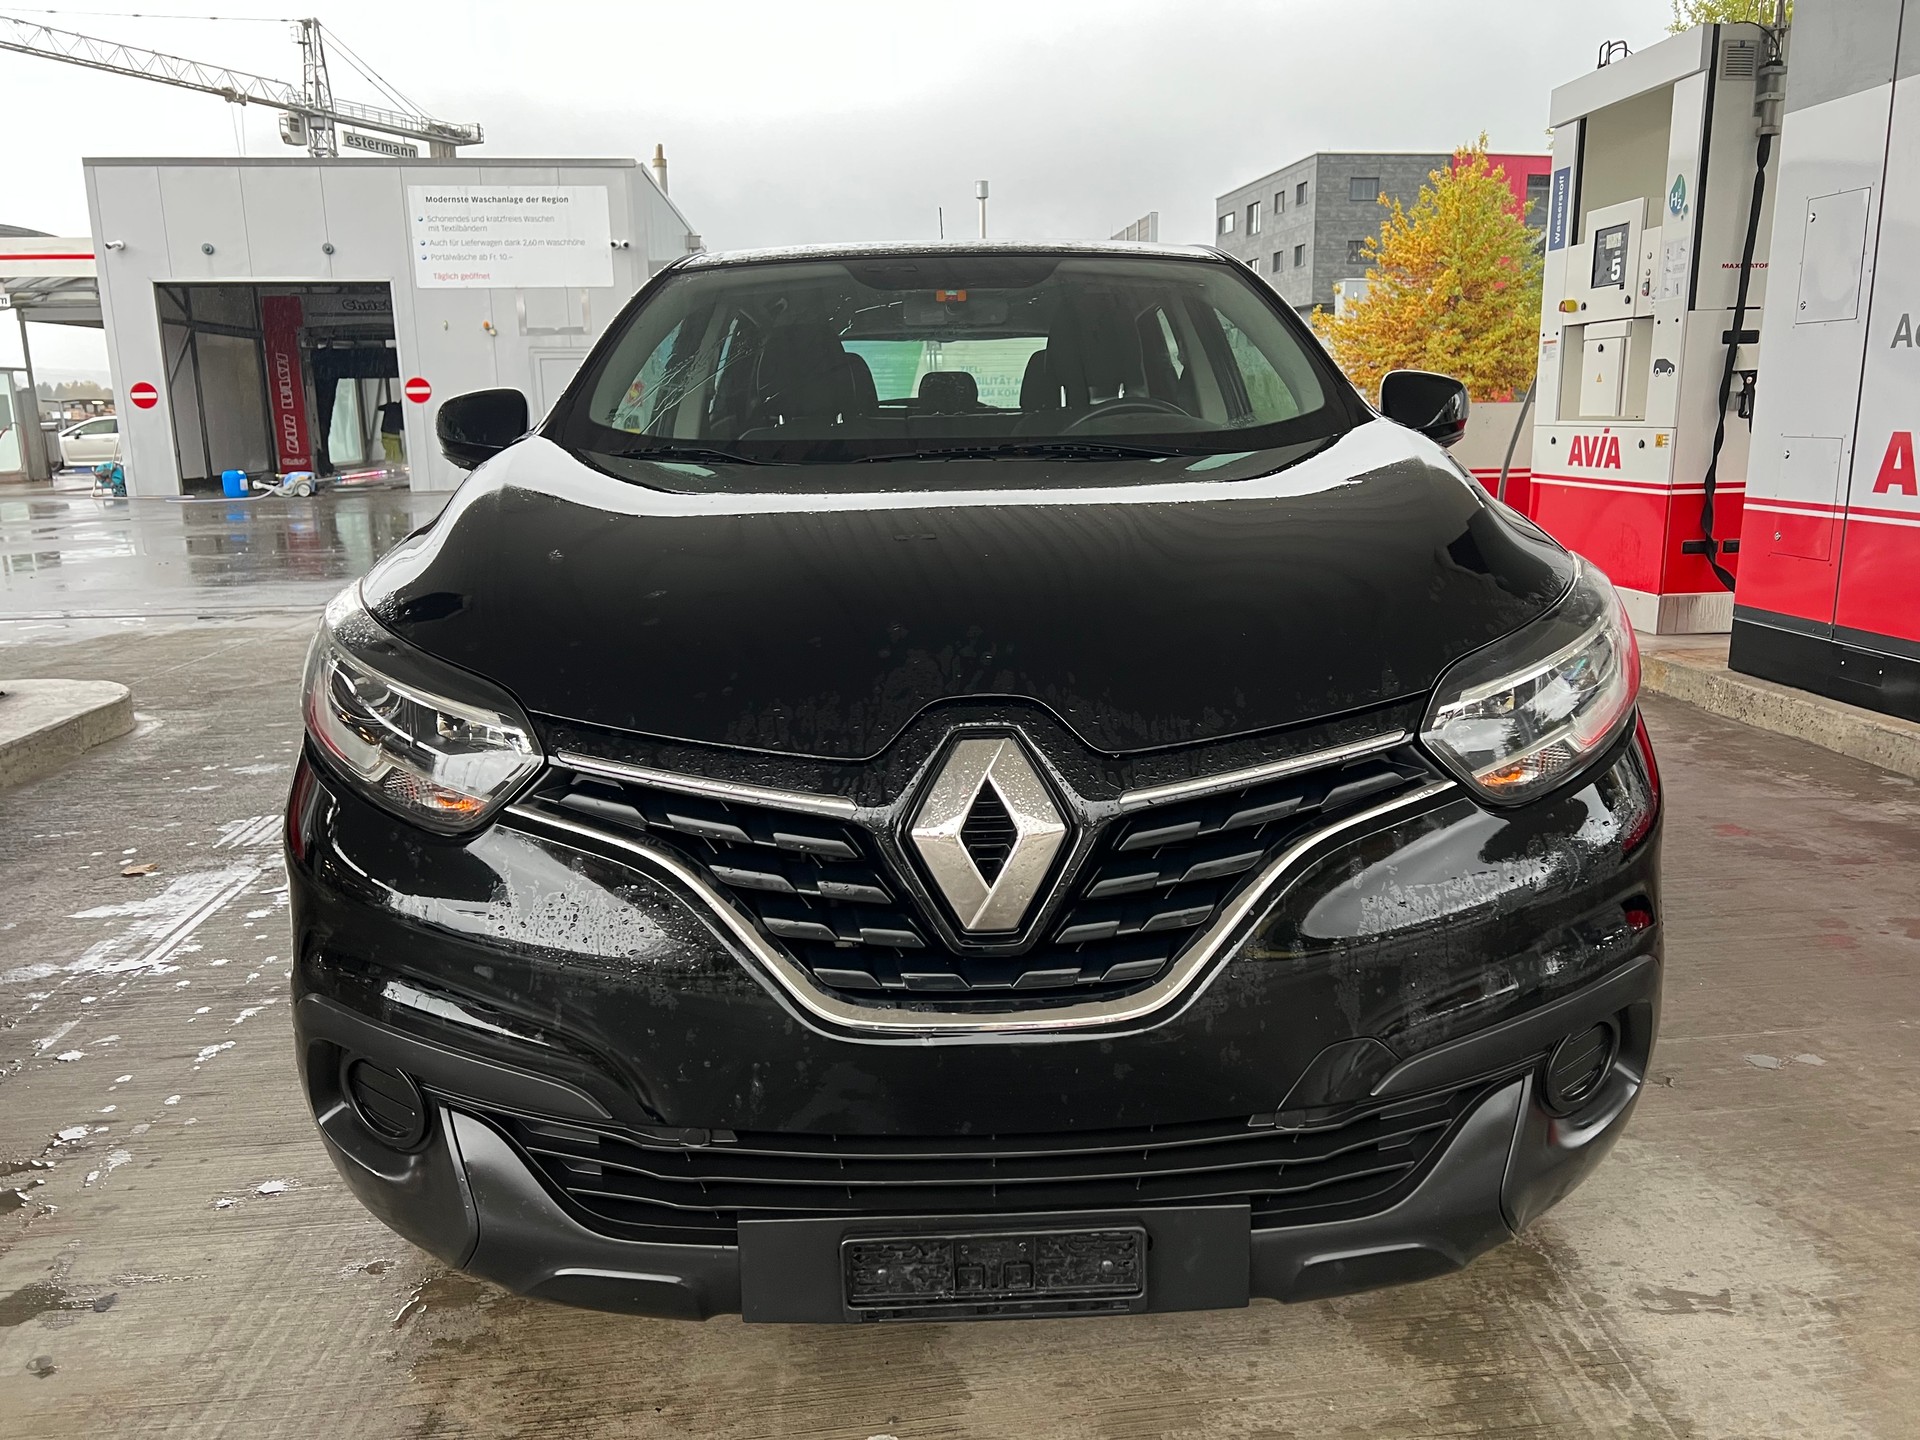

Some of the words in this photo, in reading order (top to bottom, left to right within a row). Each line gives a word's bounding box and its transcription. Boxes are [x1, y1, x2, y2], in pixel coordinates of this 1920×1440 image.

[346, 135, 416, 158] estermann
[471, 196, 524, 204] Waschanlage
[541, 196, 569, 204] Region
[1554, 175, 1565, 245] Wasserstoff
[427, 215, 470, 223] Schonendes
[471, 215, 485, 223] und
[486, 215, 522, 223] kratzfreies
[523, 215, 555, 223] Waschen
[441, 224, 488, 232] Textilbändern
[461, 239, 503, 248] Lieferwagen
[431, 253, 478, 261] Portalwäsche
[1610, 257, 1621, 281] 5
[433, 272, 459, 281] Täglich
[460, 272, 491, 281] geöffnet
[1568, 428, 1622, 469] AVIA
[1872, 432, 1920, 496] A
